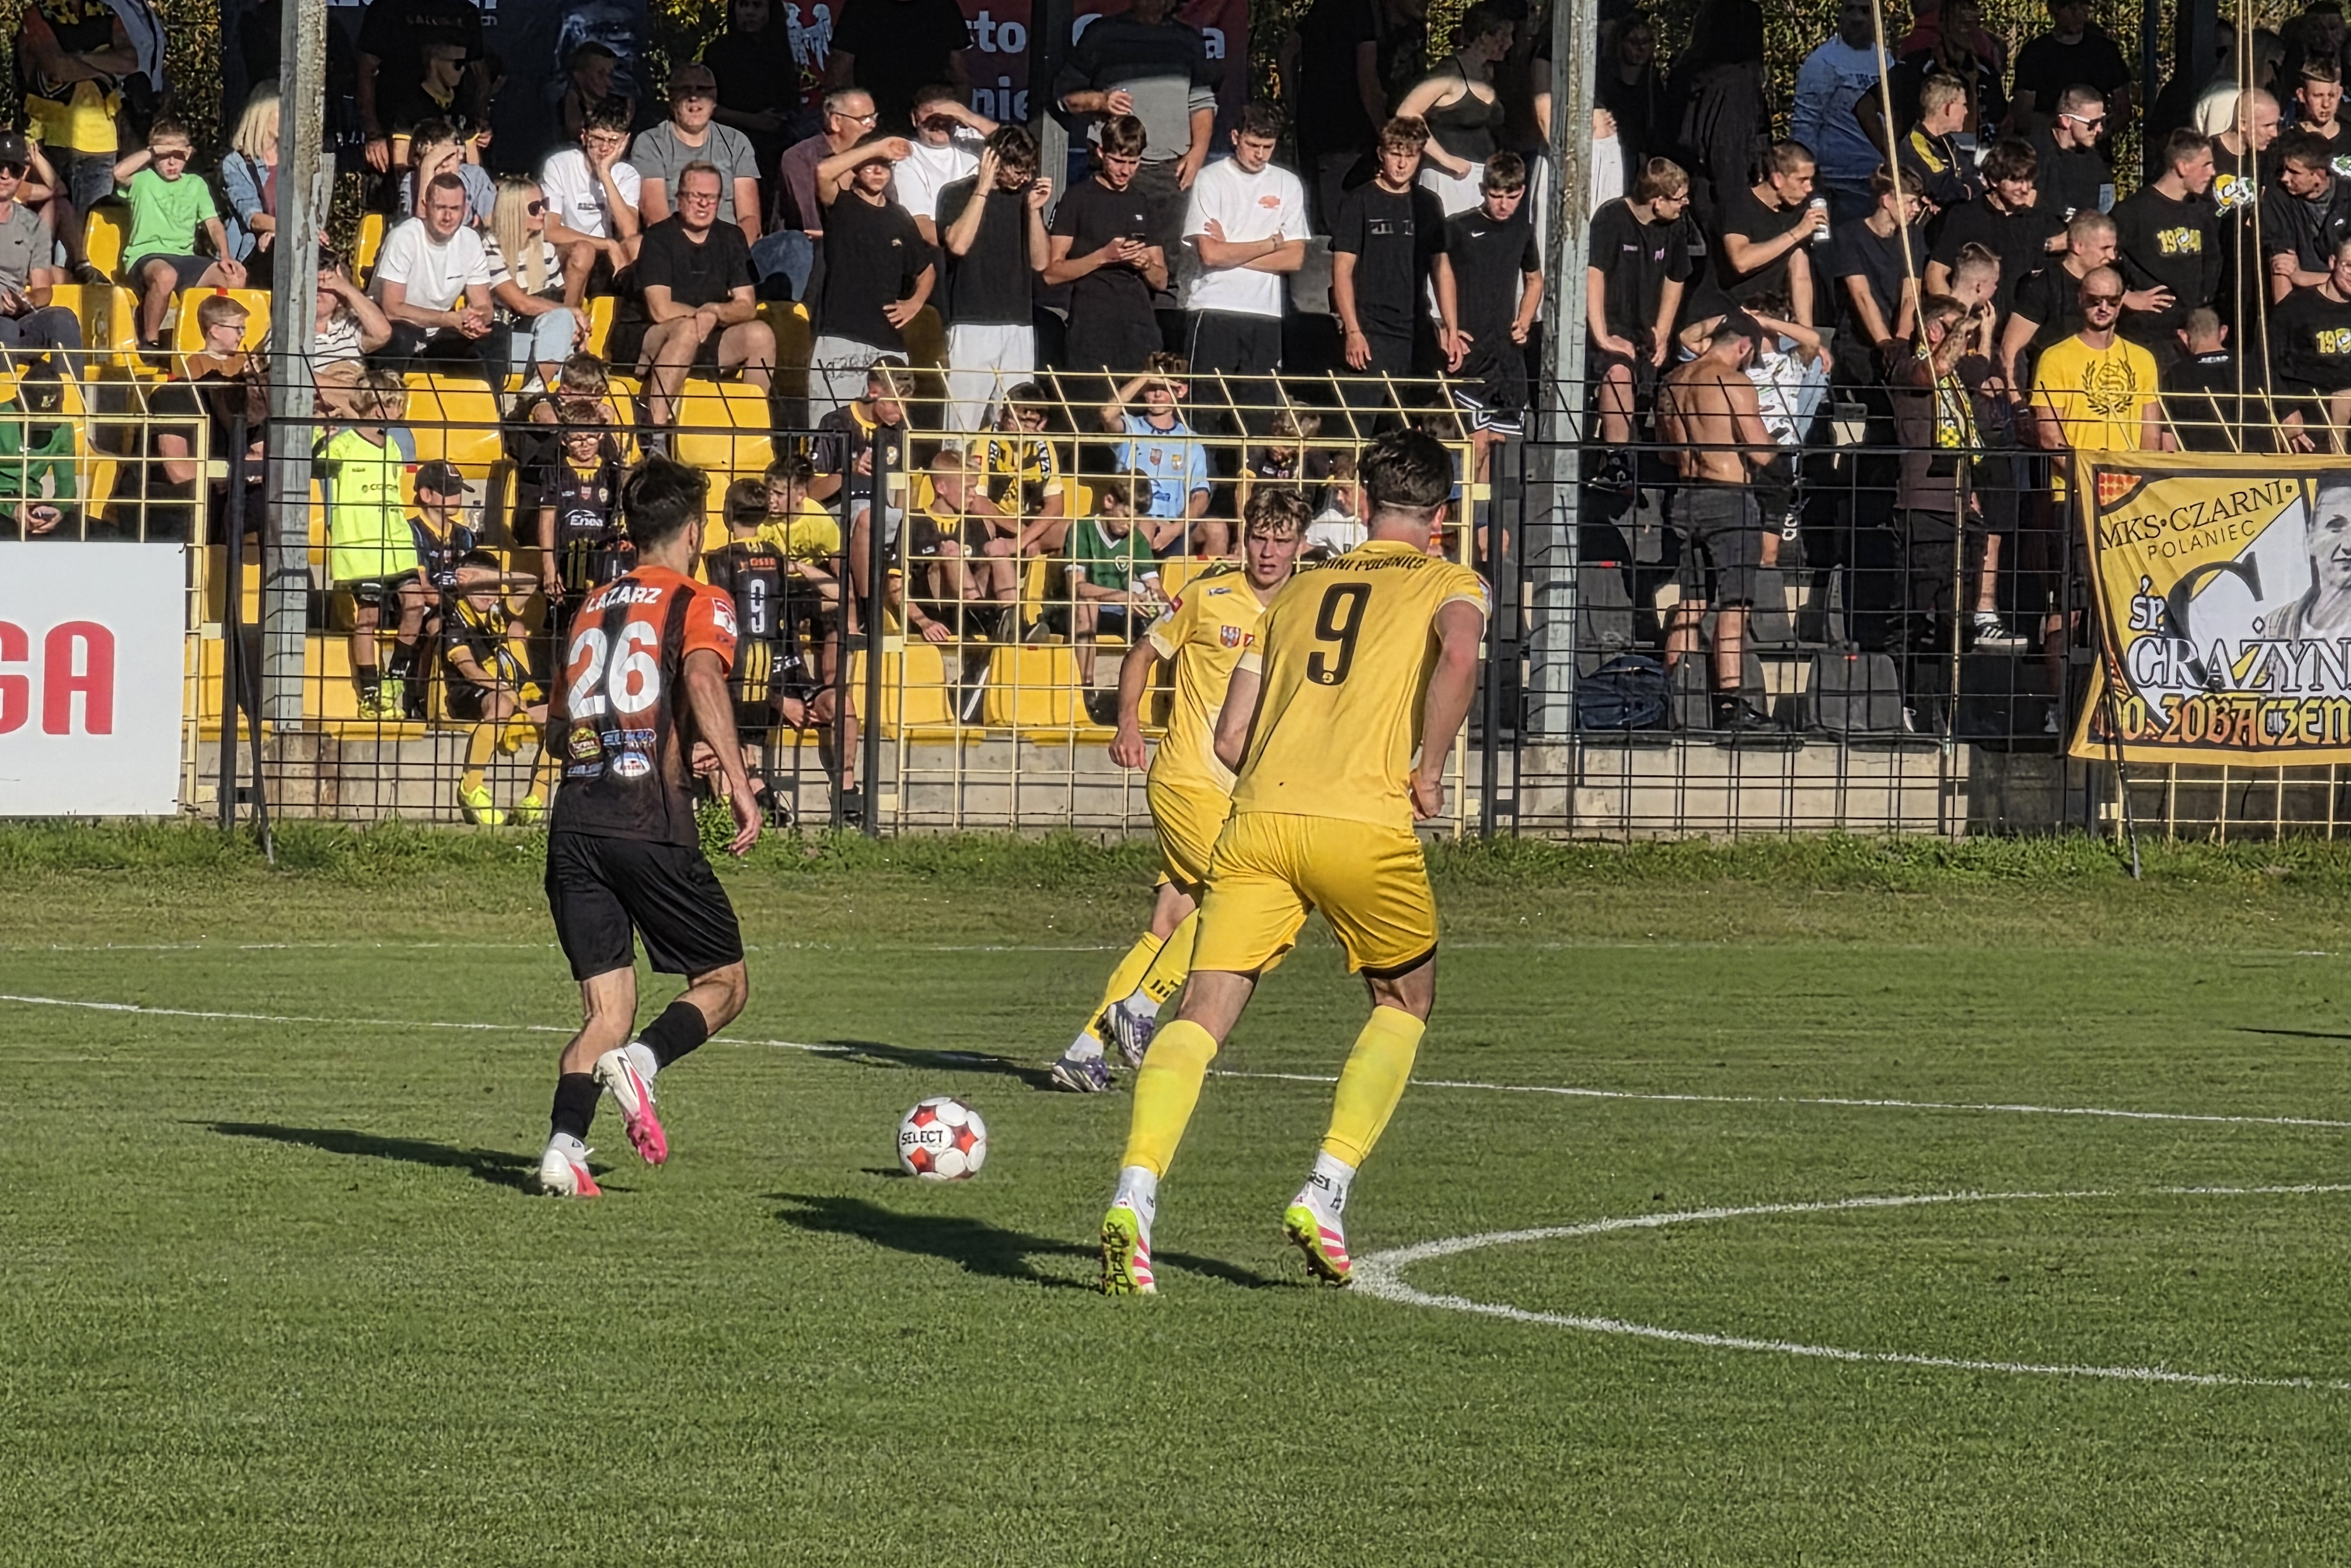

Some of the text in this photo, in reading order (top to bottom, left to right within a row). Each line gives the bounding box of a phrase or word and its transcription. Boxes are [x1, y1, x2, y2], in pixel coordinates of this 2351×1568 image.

[568, 621, 660, 719] 26
[1307, 582, 1372, 685] 9
[2128, 616, 2351, 693] GRAŻYN
[902, 1130, 943, 1145] SELECT
